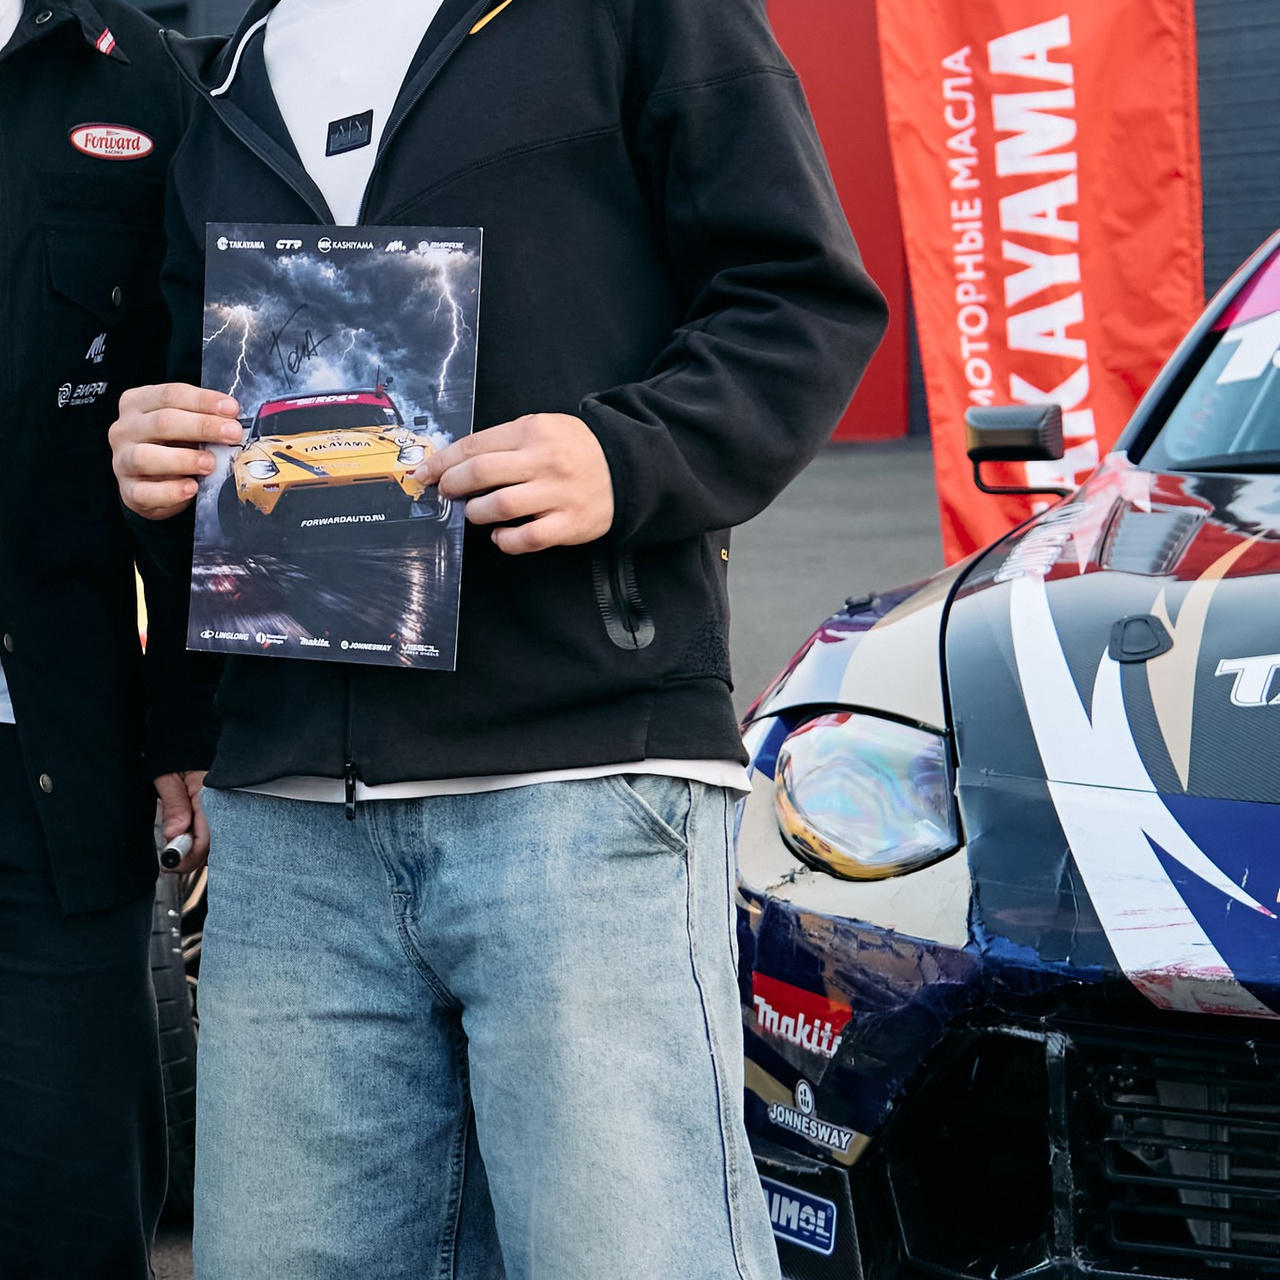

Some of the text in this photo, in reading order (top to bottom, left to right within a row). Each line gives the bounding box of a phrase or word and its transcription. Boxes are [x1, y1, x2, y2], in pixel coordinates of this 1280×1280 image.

[941, 45, 981, 190] МАСЛА
[84, 132, 141, 151] Forward
[229, 240, 265, 250] TAKAYAMA
[332, 241, 374, 250] KASHIYAMA
[987, 14, 1100, 518] AKAYAMA
[304, 440, 372, 453] TAKAYAMA
[300, 513, 386, 528] FORWARDAUTO.RU
[214, 631, 249, 641] LINGLONG
[349, 642, 392, 652] JONNESWAY
[770, 1103, 852, 1150] JONNESWAY
